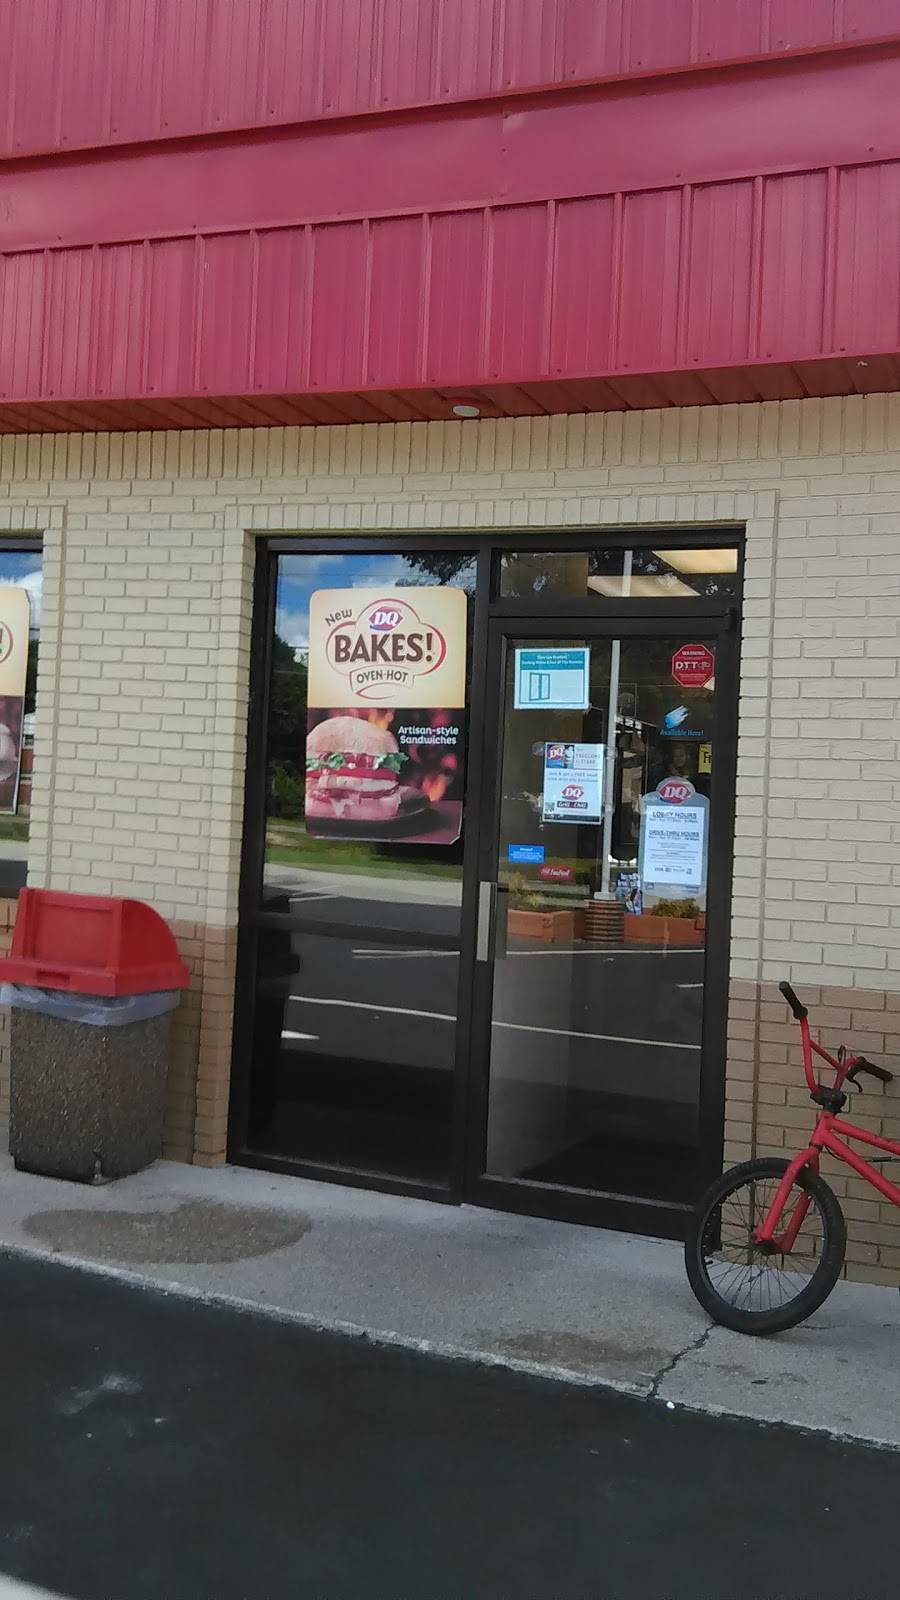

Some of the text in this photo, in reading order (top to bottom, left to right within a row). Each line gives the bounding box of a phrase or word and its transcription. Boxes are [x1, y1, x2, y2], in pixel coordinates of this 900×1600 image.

[324, 608, 353, 627] New
[373, 611, 399, 626] DQ
[334, 633, 433, 663] BAKES!
[398, 725, 459, 736] Artisan-style
[660, 728, 687, 736] Available
[400, 735, 457, 745] Sandwiches
[549, 747, 564, 758] DQ
[565, 787, 581, 798] DQ
[664, 786, 688, 800] DQ
